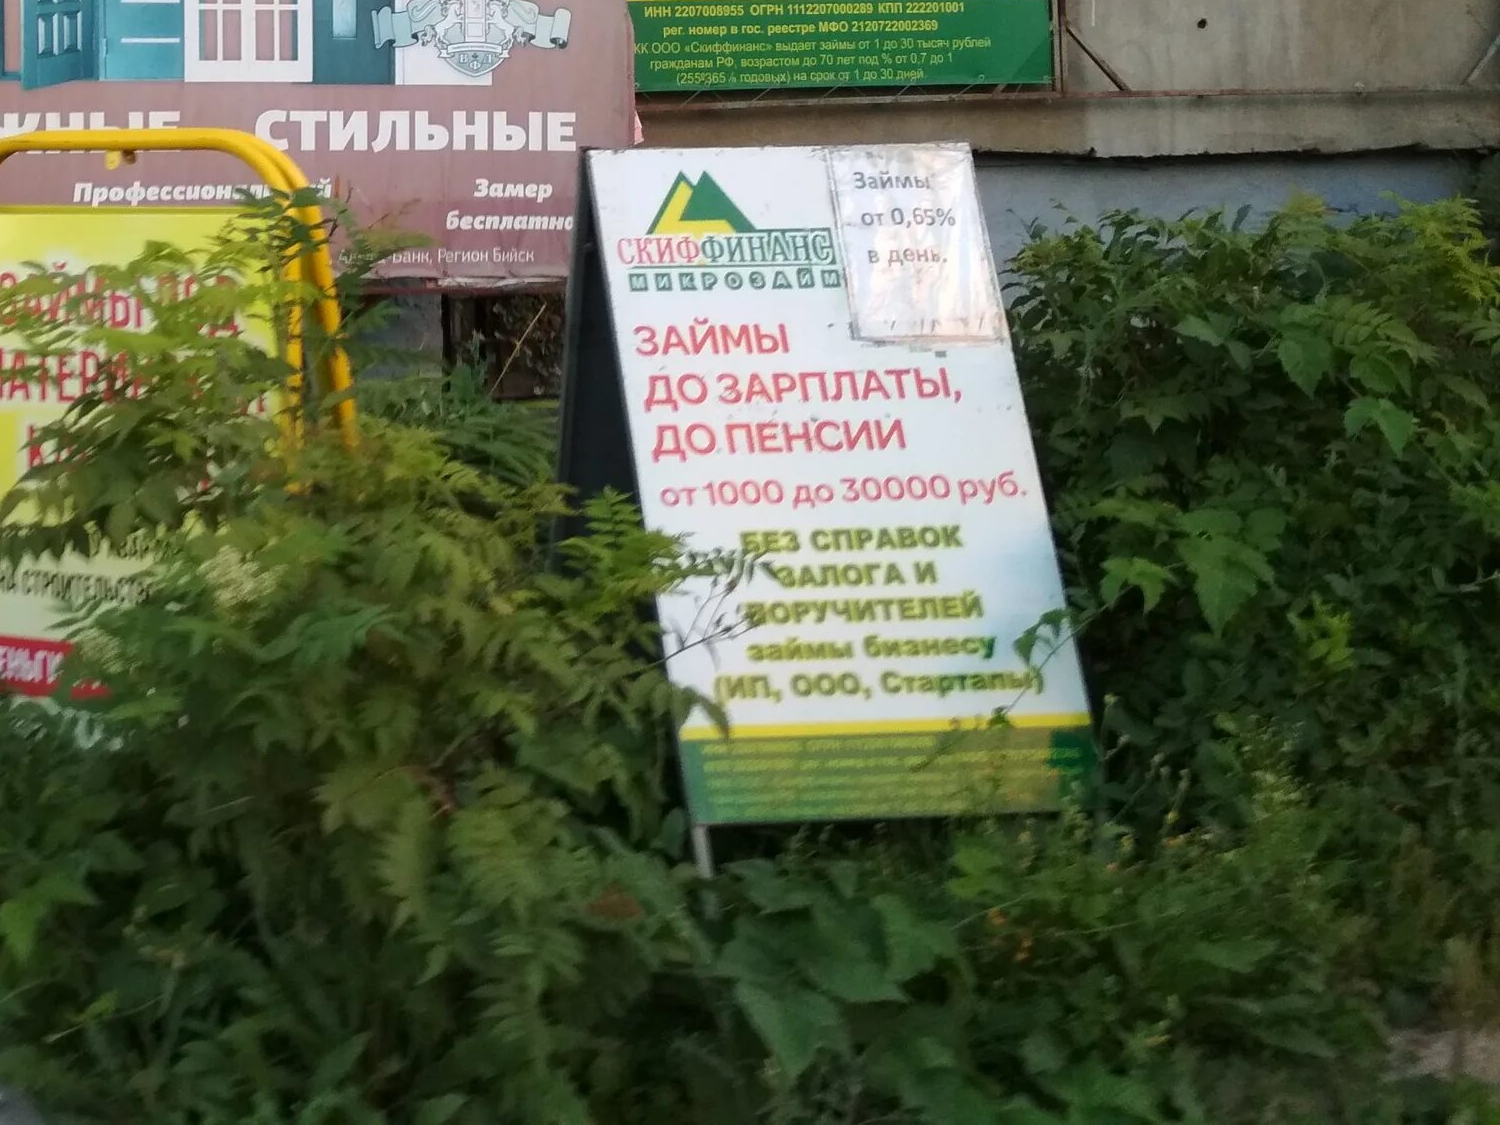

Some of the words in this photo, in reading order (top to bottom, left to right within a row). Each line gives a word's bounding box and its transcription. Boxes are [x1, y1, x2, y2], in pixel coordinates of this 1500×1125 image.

[644, 6, 671, 17] ИНН
[751, 4, 783, 16] ОГРН
[878, 3, 903, 14] КПП
[664, 26, 684, 37] рег.
[689, 25, 727, 36] номер
[731, 26, 738, 34] в
[741, 25, 764, 34] гос.
[768, 24, 815, 35] реестре
[819, 21, 849, 32] МФО
[255, 109, 576, 153] СТИЛЬНЫЕ
[474, 179, 553, 203] Замер
[853, 171, 930, 190] Займы
[446, 211, 574, 232] бесплатно
[861, 212, 884, 226] от
[891, 208, 956, 227] 0,65%
[438, 248, 488, 265] Регион
[493, 247, 534, 263] Бийск
[617, 232, 835, 265] СКИФФИНАНС
[868, 250, 880, 264] в
[888, 248, 947, 267] день.
[629, 269, 842, 291] МИКРОЗАЙМ
[633, 317, 790, 356] ЗАЙМЫ
[644, 373, 709, 413] ДО
[719, 368, 962, 405] ЗАРПЛАТЫ,
[651, 421, 716, 463] ДО
[726, 418, 906, 455] ПЕНСИИ
[661, 486, 696, 508] от
[703, 479, 783, 507] 1000
[792, 480, 832, 509] до
[841, 475, 951, 503] 30000
[959, 472, 1027, 507] руб.
[740, 531, 801, 553] БЕЗ
[810, 525, 963, 551] СПРАВОК
[776, 562, 905, 587] ЗАЛОГА
[913, 561, 938, 584] И
[747, 638, 854, 661] займы
[863, 635, 996, 659] бизнесу
[715, 675, 782, 704] (ИП,
[790, 673, 871, 699] ООО,
[881, 669, 1043, 696] Стартапы)
